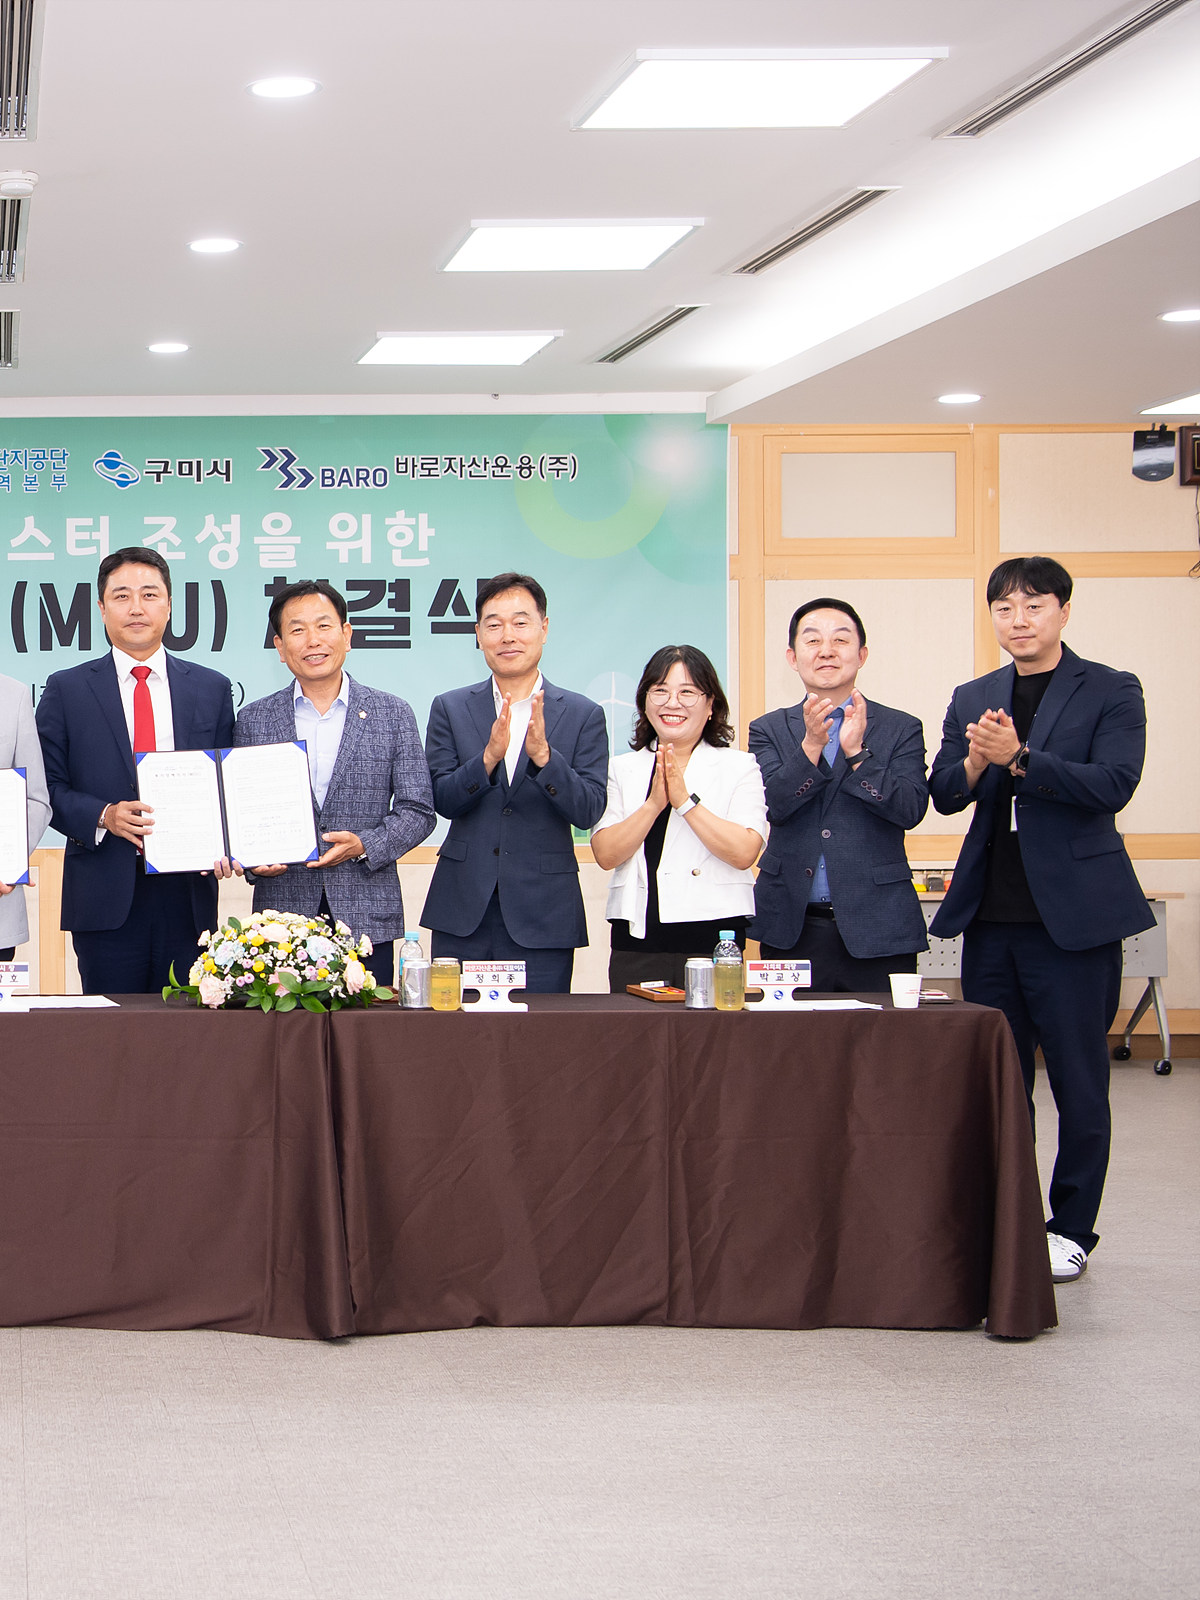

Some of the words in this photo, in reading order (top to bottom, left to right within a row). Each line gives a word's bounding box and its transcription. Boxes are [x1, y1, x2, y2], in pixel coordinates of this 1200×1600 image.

[145, 459, 232, 484] 구미시
[320, 467, 390, 489] BARO
[395, 454, 578, 482] 바로자산운용(주)
[142, 512, 301, 570] 조성을
[326, 509, 436, 567] 위한
